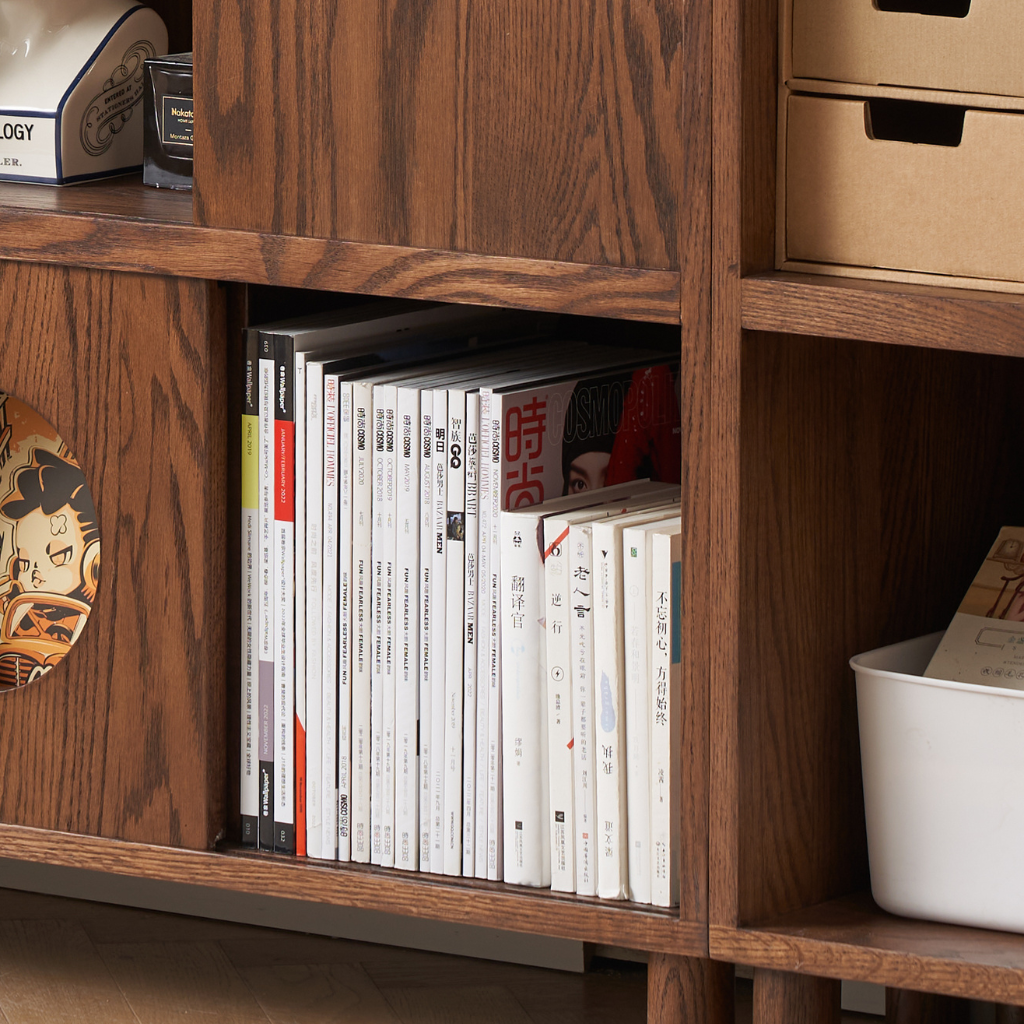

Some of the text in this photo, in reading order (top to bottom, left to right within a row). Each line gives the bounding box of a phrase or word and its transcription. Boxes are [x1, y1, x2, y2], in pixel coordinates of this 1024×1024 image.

[104, 84, 133, 105] ENTERED AT
[435, 428, 445, 453] 明日
[450, 443, 462, 469] GQ
[326, 449, 335, 487] HOMMES
[480, 463, 489, 500] HOMMES
[511, 575, 526, 629] 翻译官
[573, 565, 591, 619] 老人言
[551, 592, 563, 635] 逆行
[467, 622, 475, 645] MEN
